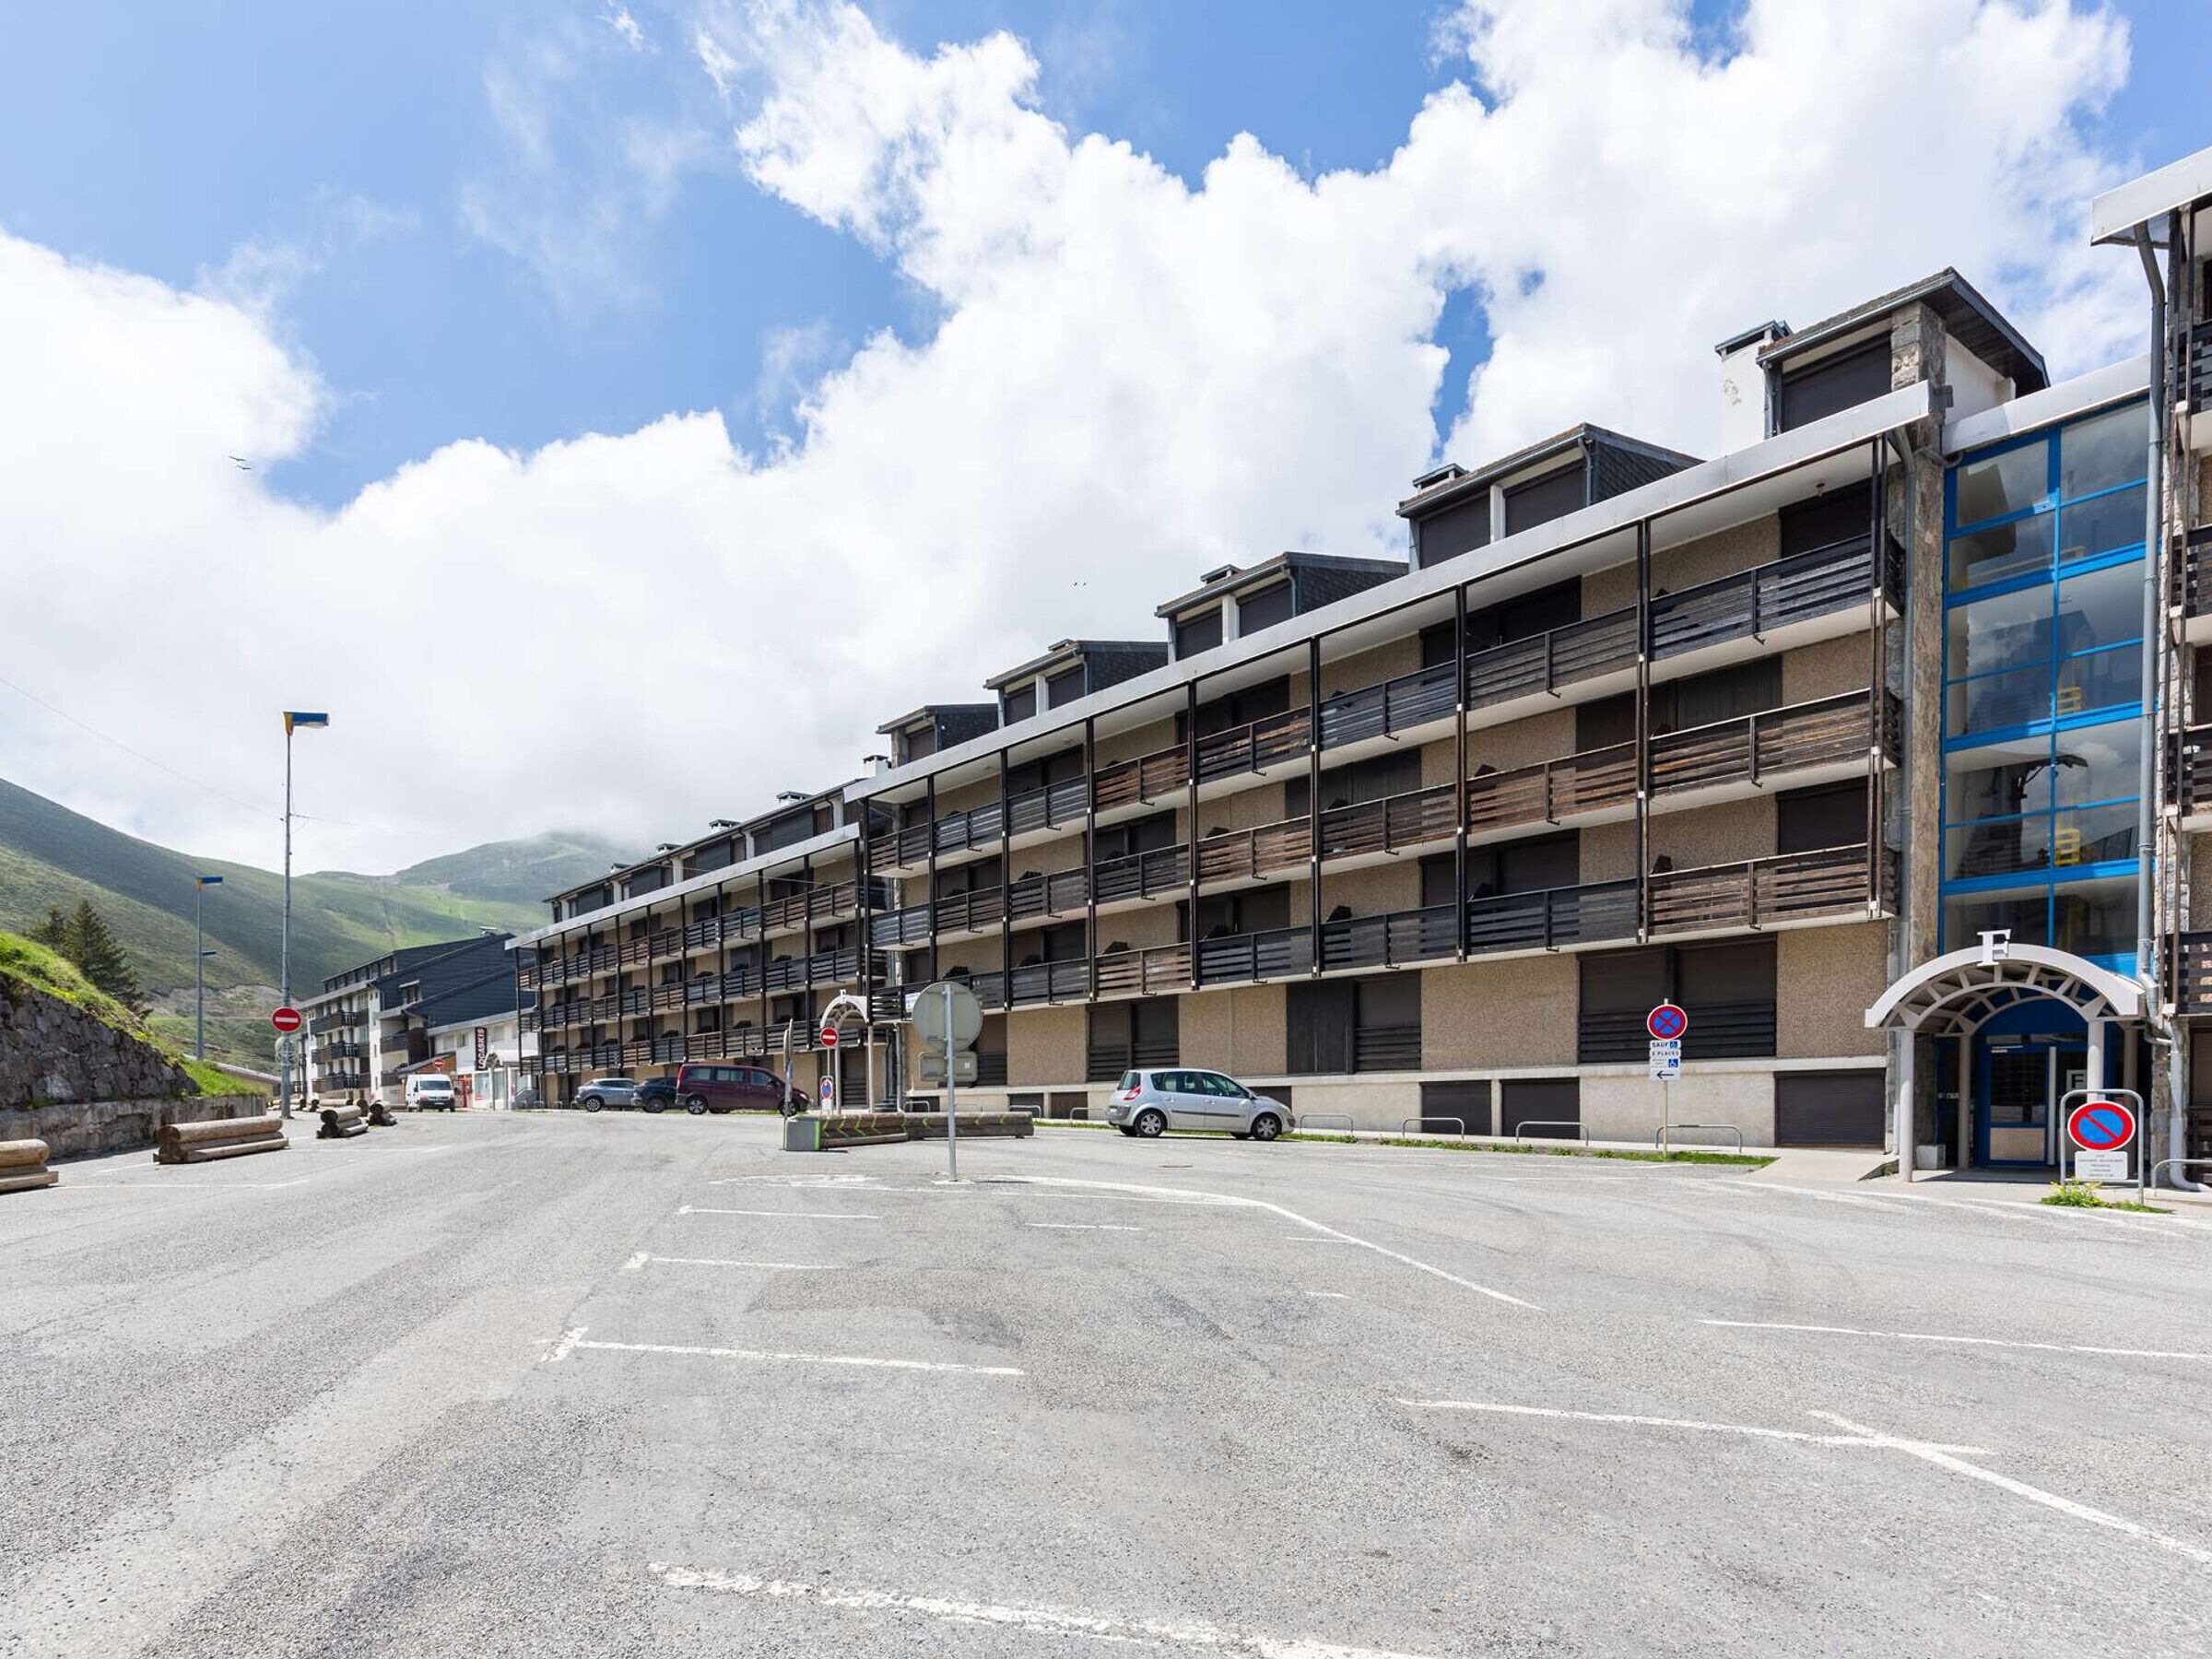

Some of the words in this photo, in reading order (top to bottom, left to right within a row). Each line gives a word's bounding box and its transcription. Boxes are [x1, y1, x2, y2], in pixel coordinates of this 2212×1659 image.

[1976, 928, 2011, 967] F
[477, 1028, 486, 1069] LOCASKIS
[2071, 1074, 2085, 1088] F
